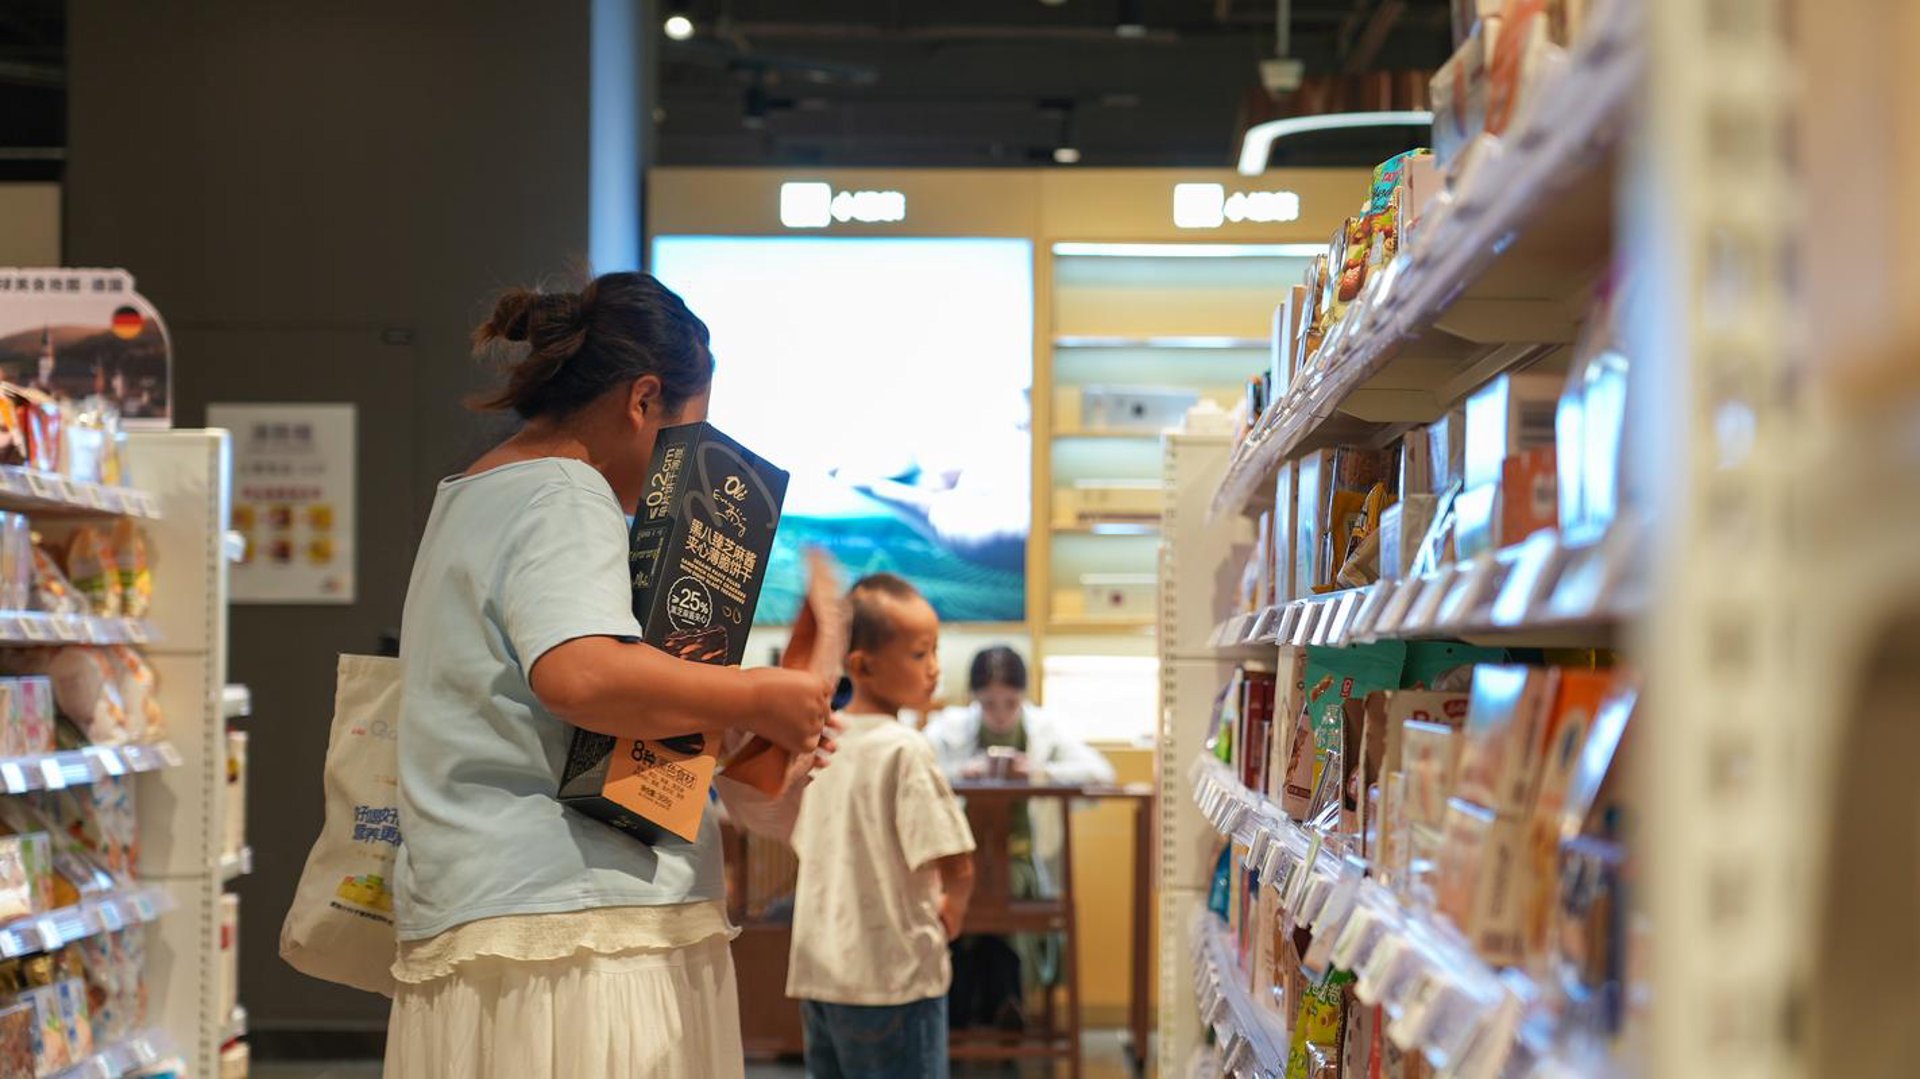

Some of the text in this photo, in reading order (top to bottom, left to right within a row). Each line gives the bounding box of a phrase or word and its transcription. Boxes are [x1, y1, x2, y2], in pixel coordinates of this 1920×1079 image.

[685, 535, 753, 583] 夹心薄脆饼干
